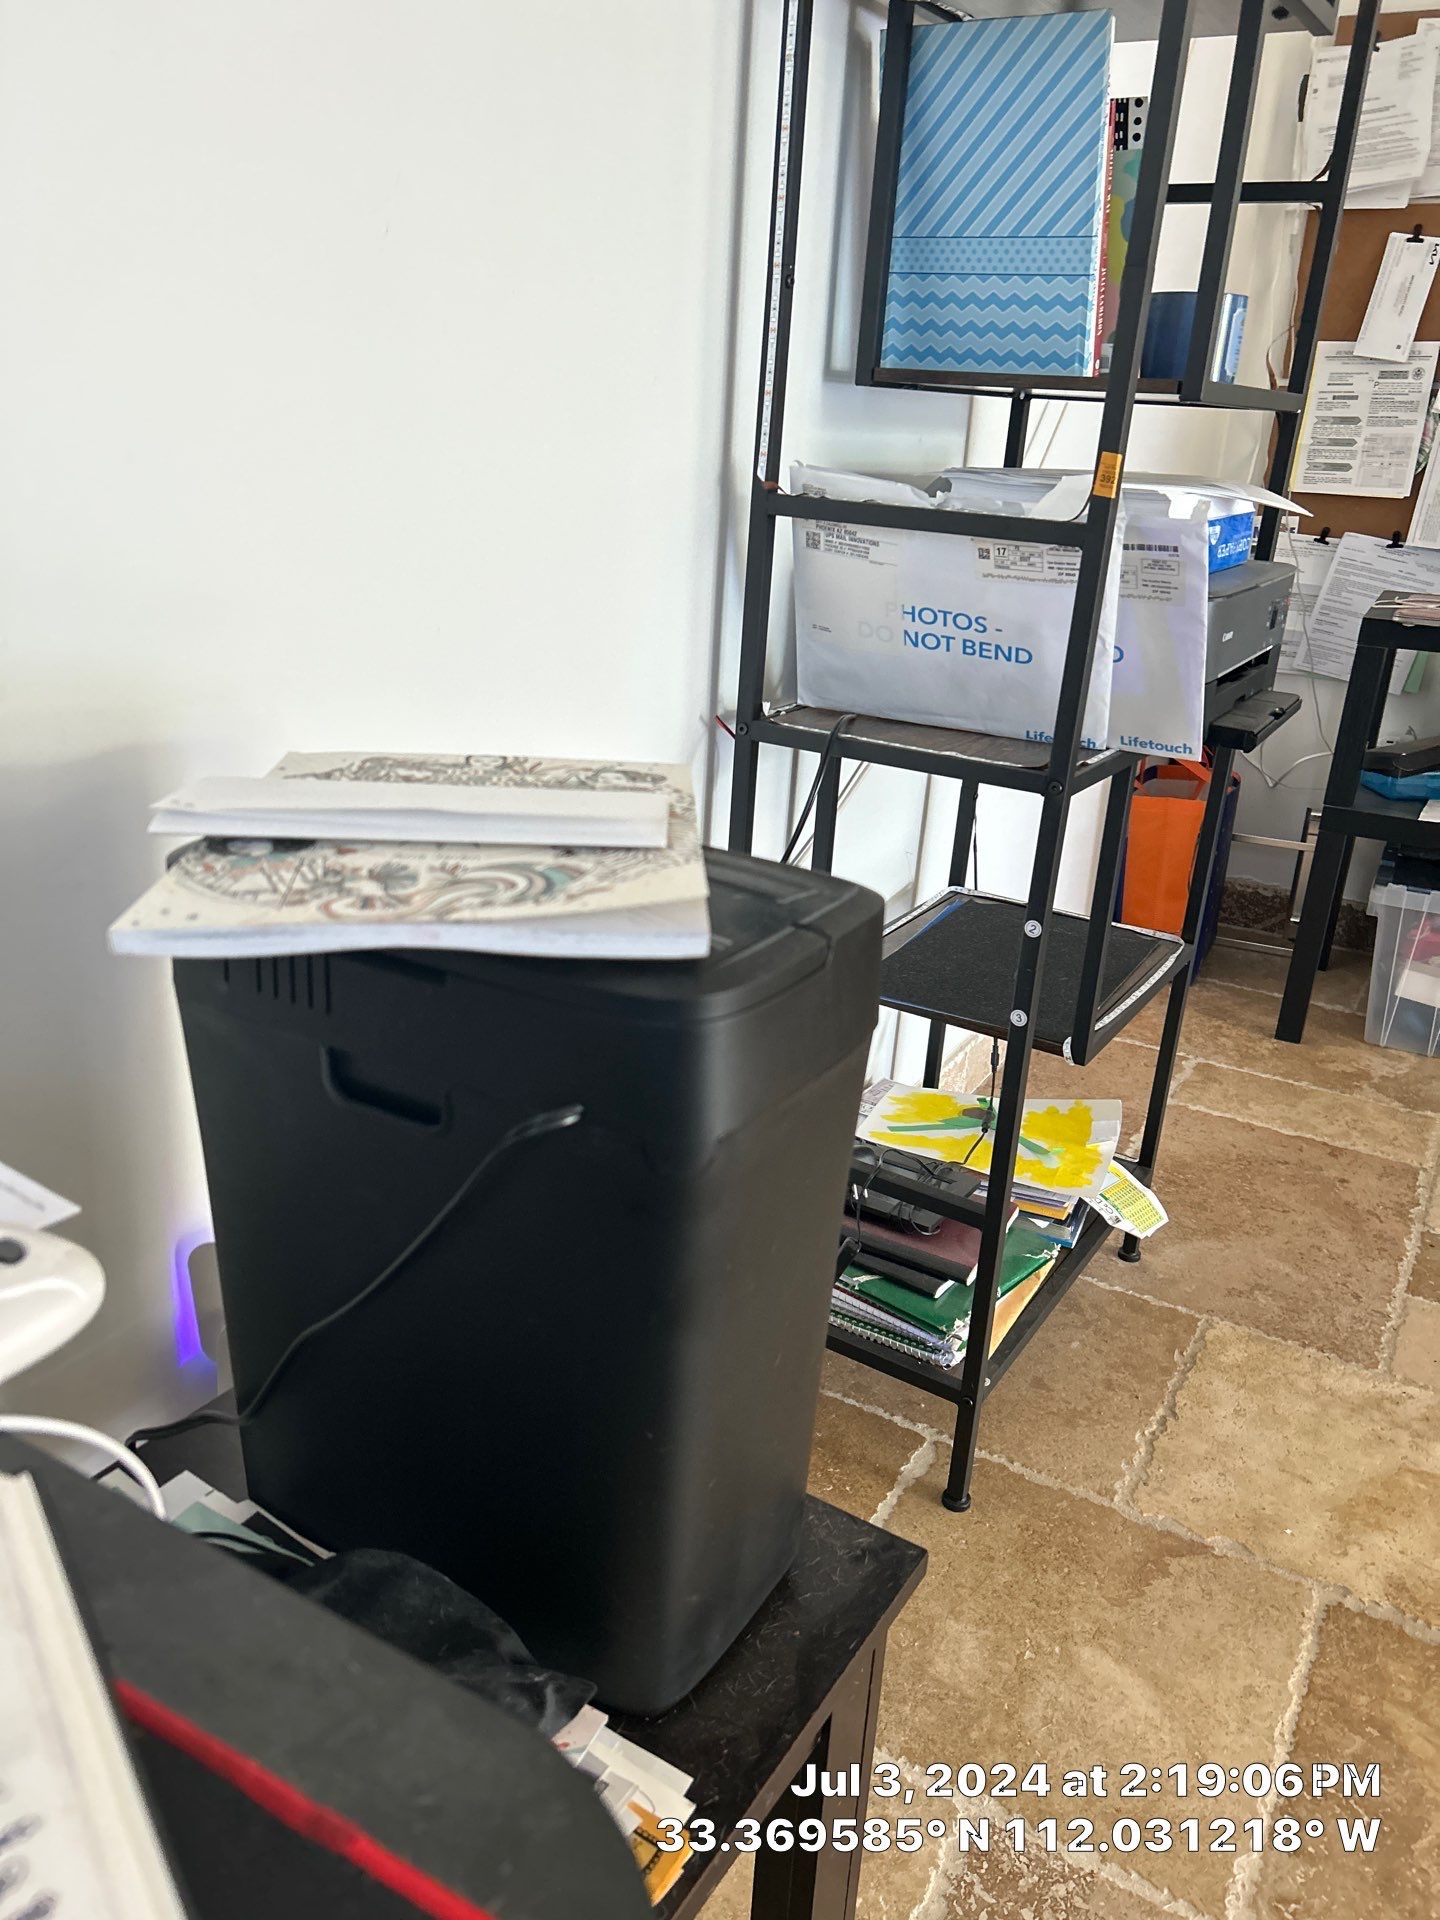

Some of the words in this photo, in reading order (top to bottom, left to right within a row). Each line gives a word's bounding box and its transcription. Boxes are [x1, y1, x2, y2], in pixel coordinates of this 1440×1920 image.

[1100, 474, 1115, 484] 392
[996, 547, 1006, 556] 17
[885, 601, 987, 634] PHOTOS
[903, 629, 956, 652] NOT
[962, 638, 1033, 664] BEND
[1120, 735, 1193, 755] Lifetouch
